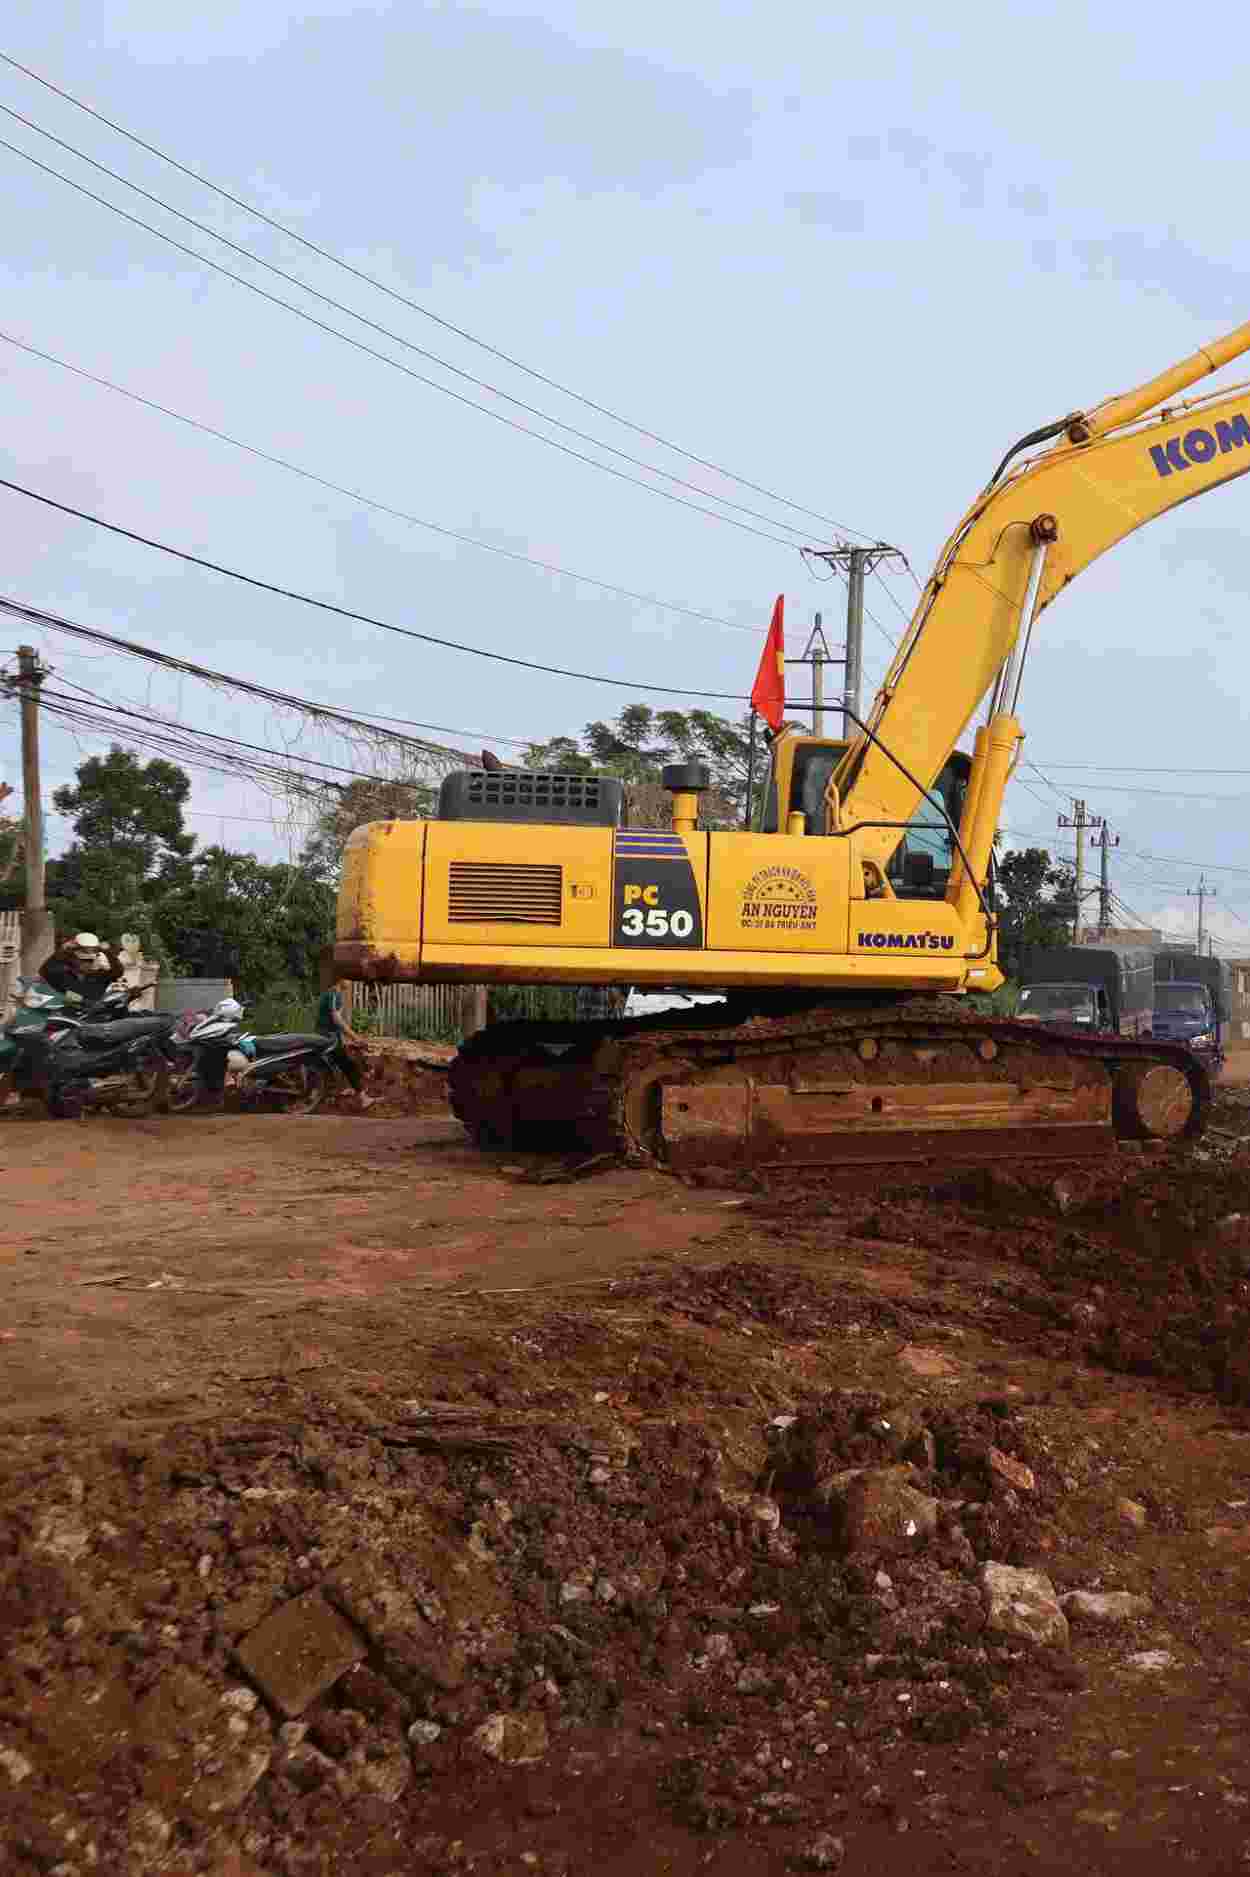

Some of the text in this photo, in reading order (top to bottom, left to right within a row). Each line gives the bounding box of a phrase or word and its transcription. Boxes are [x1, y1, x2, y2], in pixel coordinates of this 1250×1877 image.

[623, 884, 658, 906] PC
[741, 903, 761, 917] AN
[621, 908, 694, 937] 350
[857, 931, 955, 949] KOMATSU
